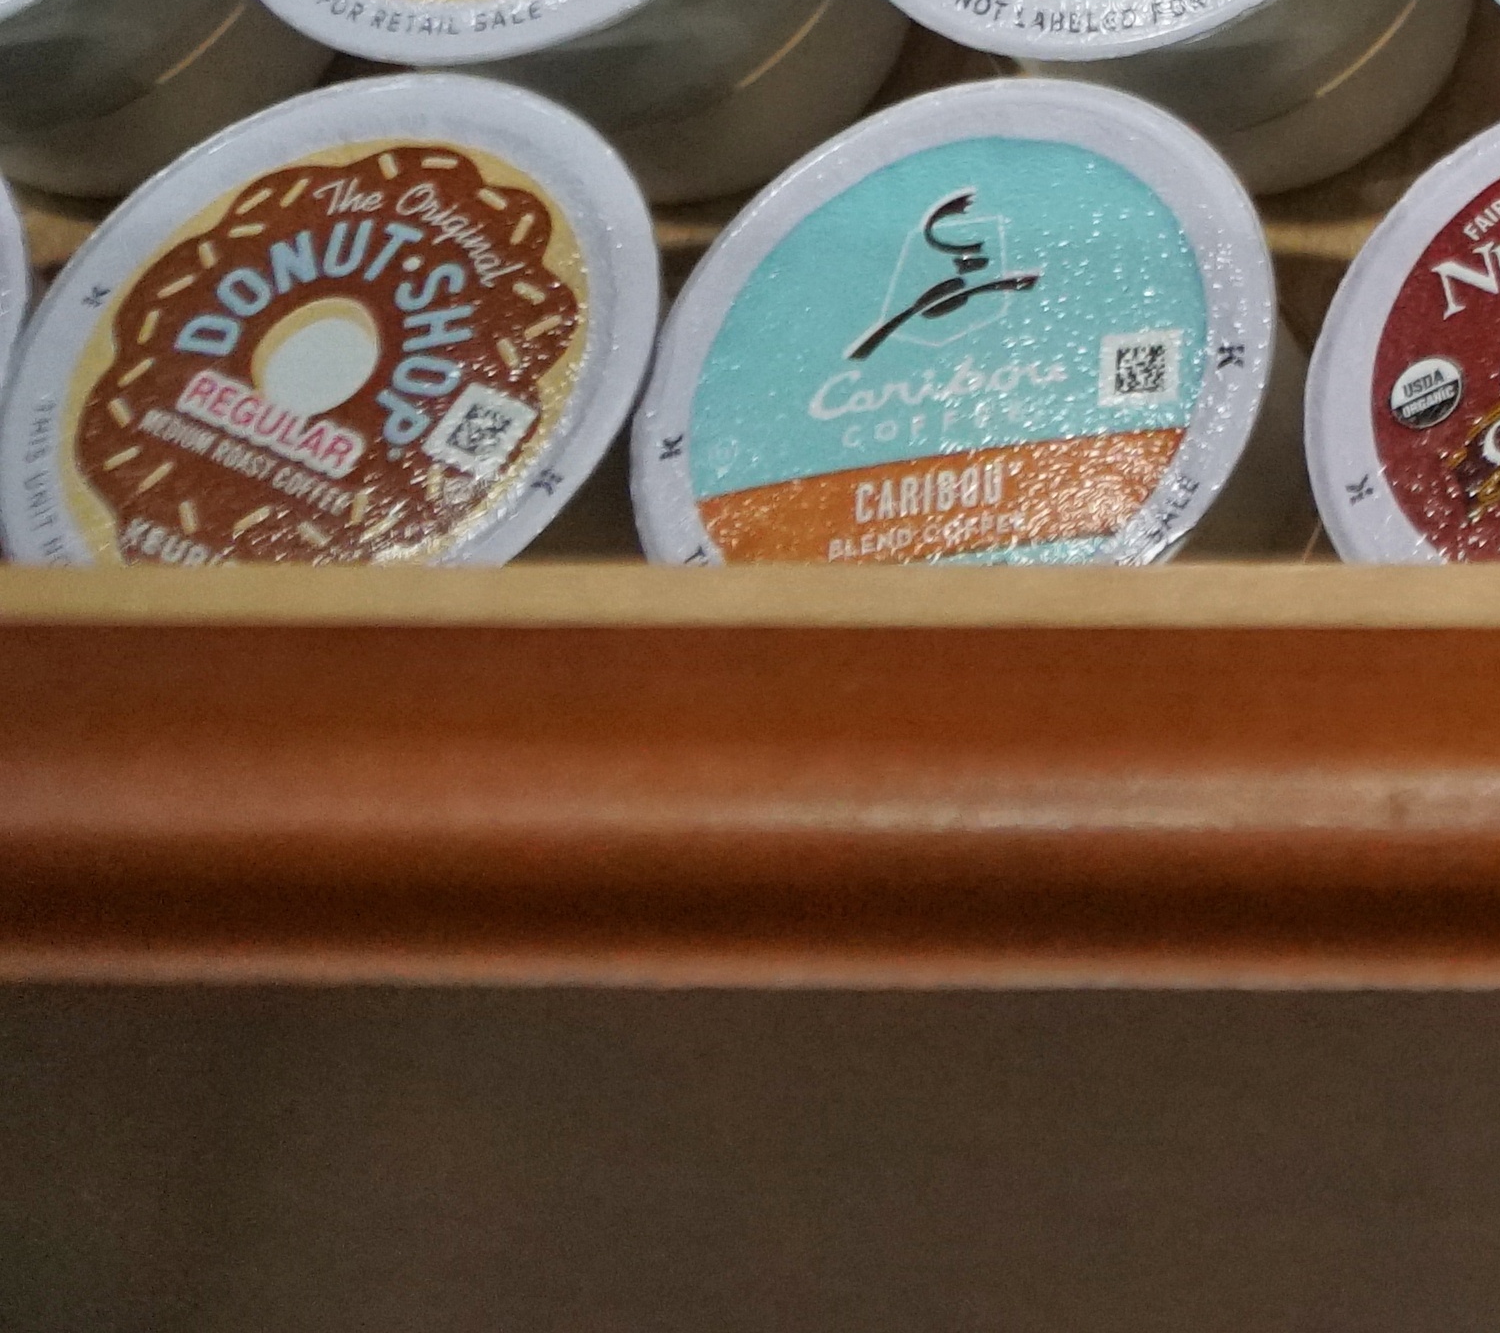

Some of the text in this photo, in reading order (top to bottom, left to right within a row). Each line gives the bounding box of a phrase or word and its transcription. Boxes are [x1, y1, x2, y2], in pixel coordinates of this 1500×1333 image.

[313, 177, 520, 289] The Original
[175, 218, 479, 451] DONUT SHOP
[188, 376, 355, 474] REGULAR
[851, 462, 1005, 524] CARIBOU
